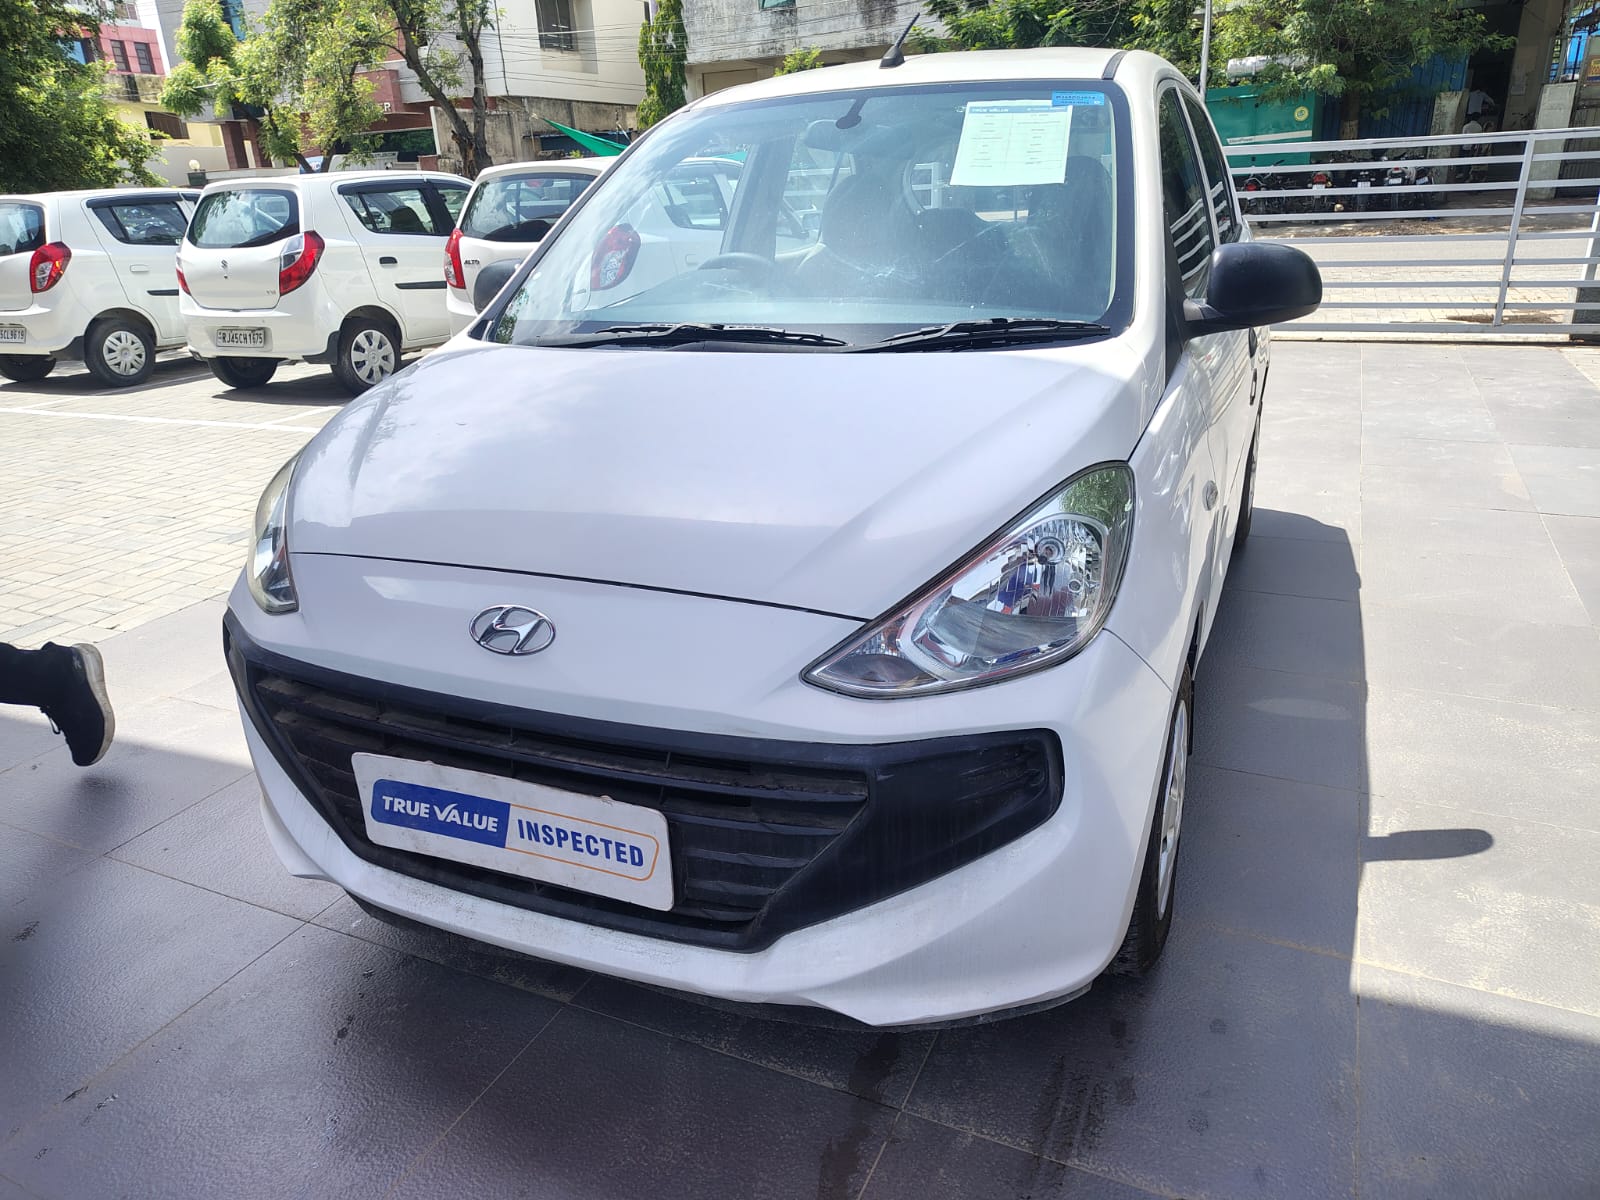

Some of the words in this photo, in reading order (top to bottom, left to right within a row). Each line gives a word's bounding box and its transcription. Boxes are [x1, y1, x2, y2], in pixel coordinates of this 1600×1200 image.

[382, 795, 430, 818] TRUE
[433, 803, 499, 833] VALUE
[517, 818, 645, 868] INSPECTED
